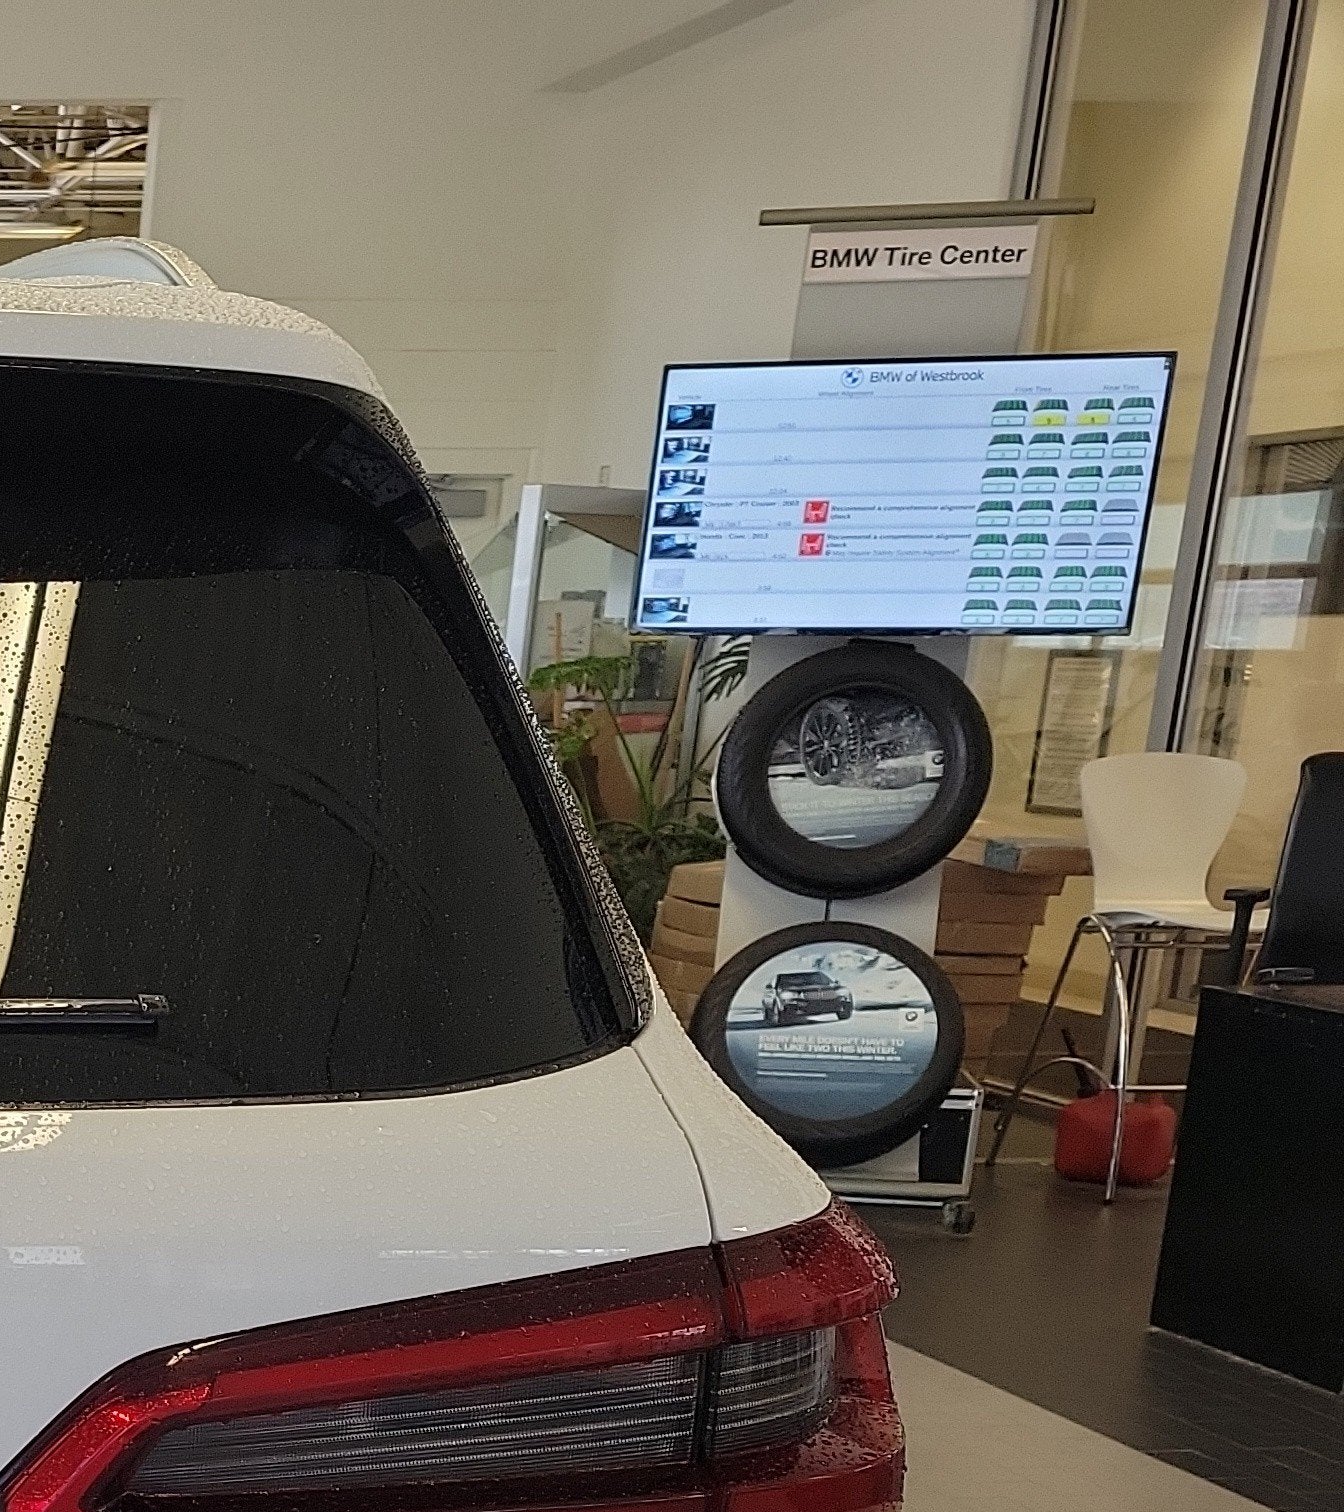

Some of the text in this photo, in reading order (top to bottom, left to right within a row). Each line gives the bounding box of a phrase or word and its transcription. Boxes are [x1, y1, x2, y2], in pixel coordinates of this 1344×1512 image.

[810, 244, 1027, 268] BMW Tire Center
[869, 369, 985, 383] BMW of Westbrook
